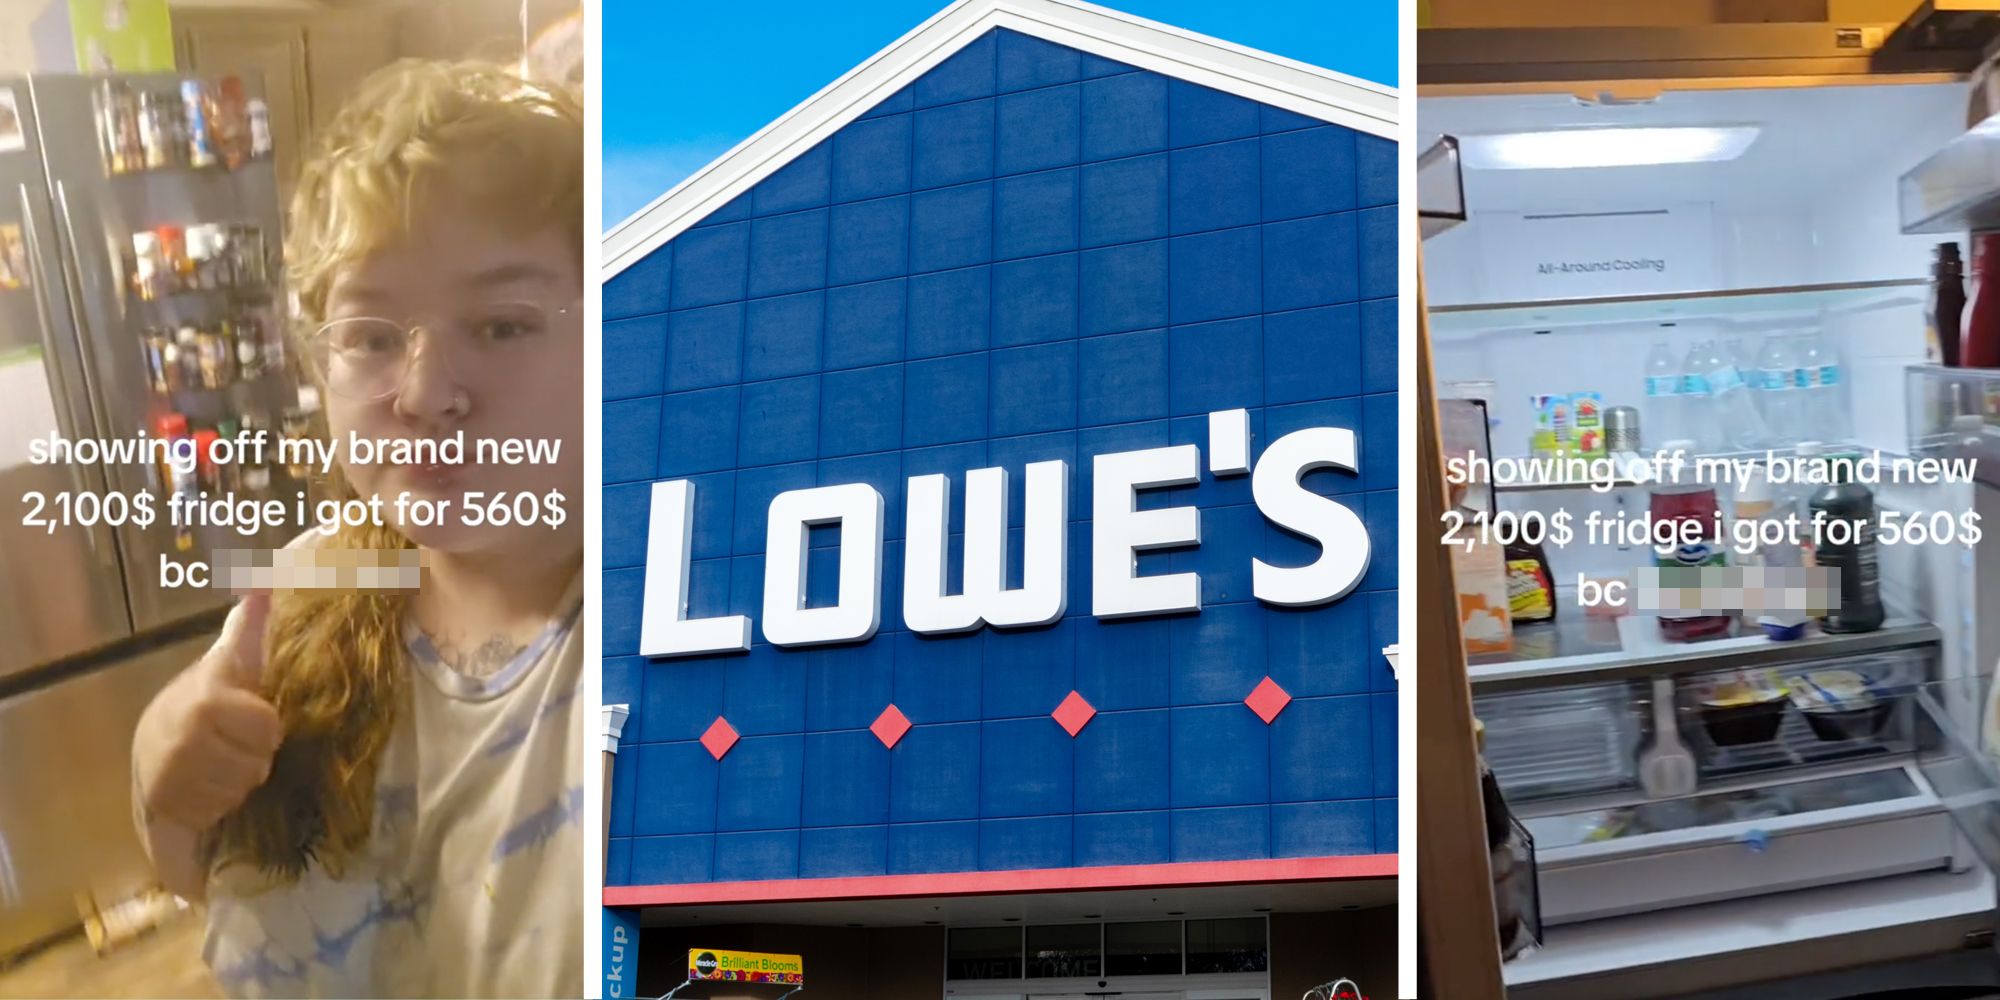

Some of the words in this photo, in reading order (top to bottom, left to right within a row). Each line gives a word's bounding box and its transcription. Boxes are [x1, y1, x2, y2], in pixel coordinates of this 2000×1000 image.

[1538, 261, 1610, 274] All-Around
[1612, 258, 1664, 272] Cooling
[640, 408, 1371, 660] LOWE'S
[721, 956, 759, 969] Brilliant
[761, 958, 799, 971] Blooms
